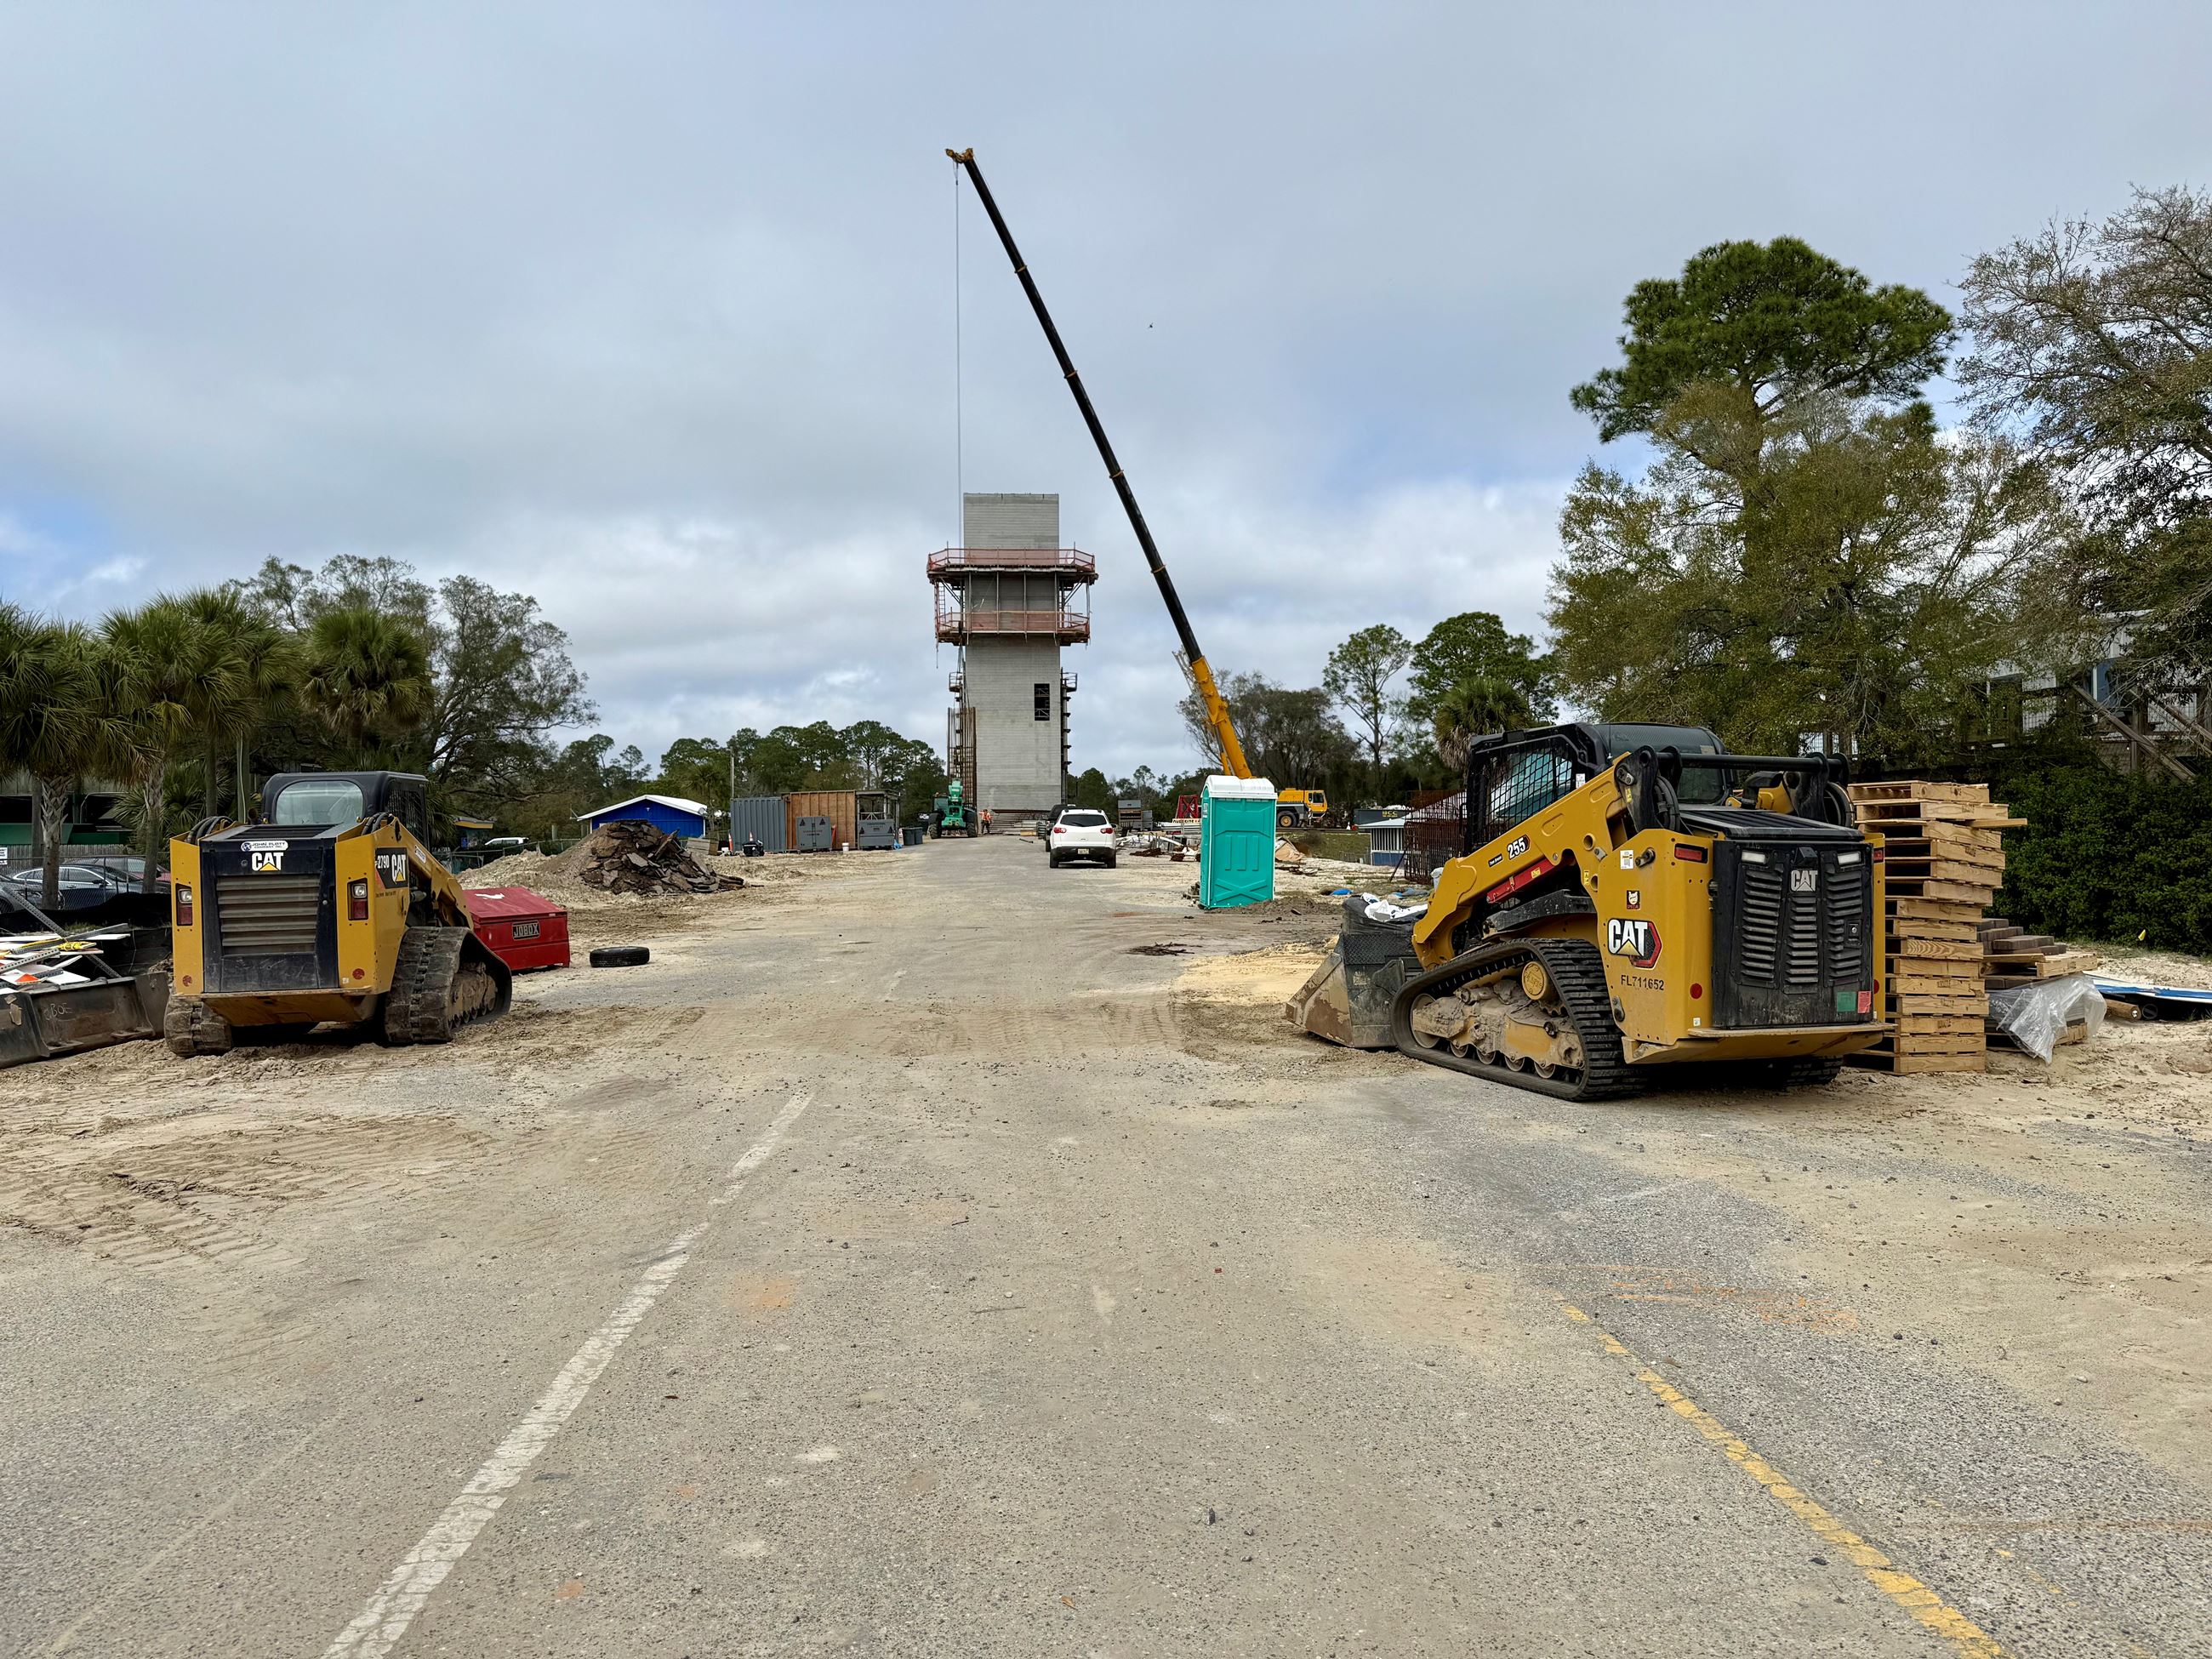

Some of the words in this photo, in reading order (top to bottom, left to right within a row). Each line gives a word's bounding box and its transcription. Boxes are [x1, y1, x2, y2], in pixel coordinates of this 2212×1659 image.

[1508, 837, 1525, 859] 255
[251, 852, 284, 872] CAT
[391, 854, 407, 884] CAT
[1790, 869, 1819, 892] CAT
[513, 923, 539, 937] JOBOX
[1608, 919, 1649, 957] CAT
[1621, 974, 1664, 991] FL711652
